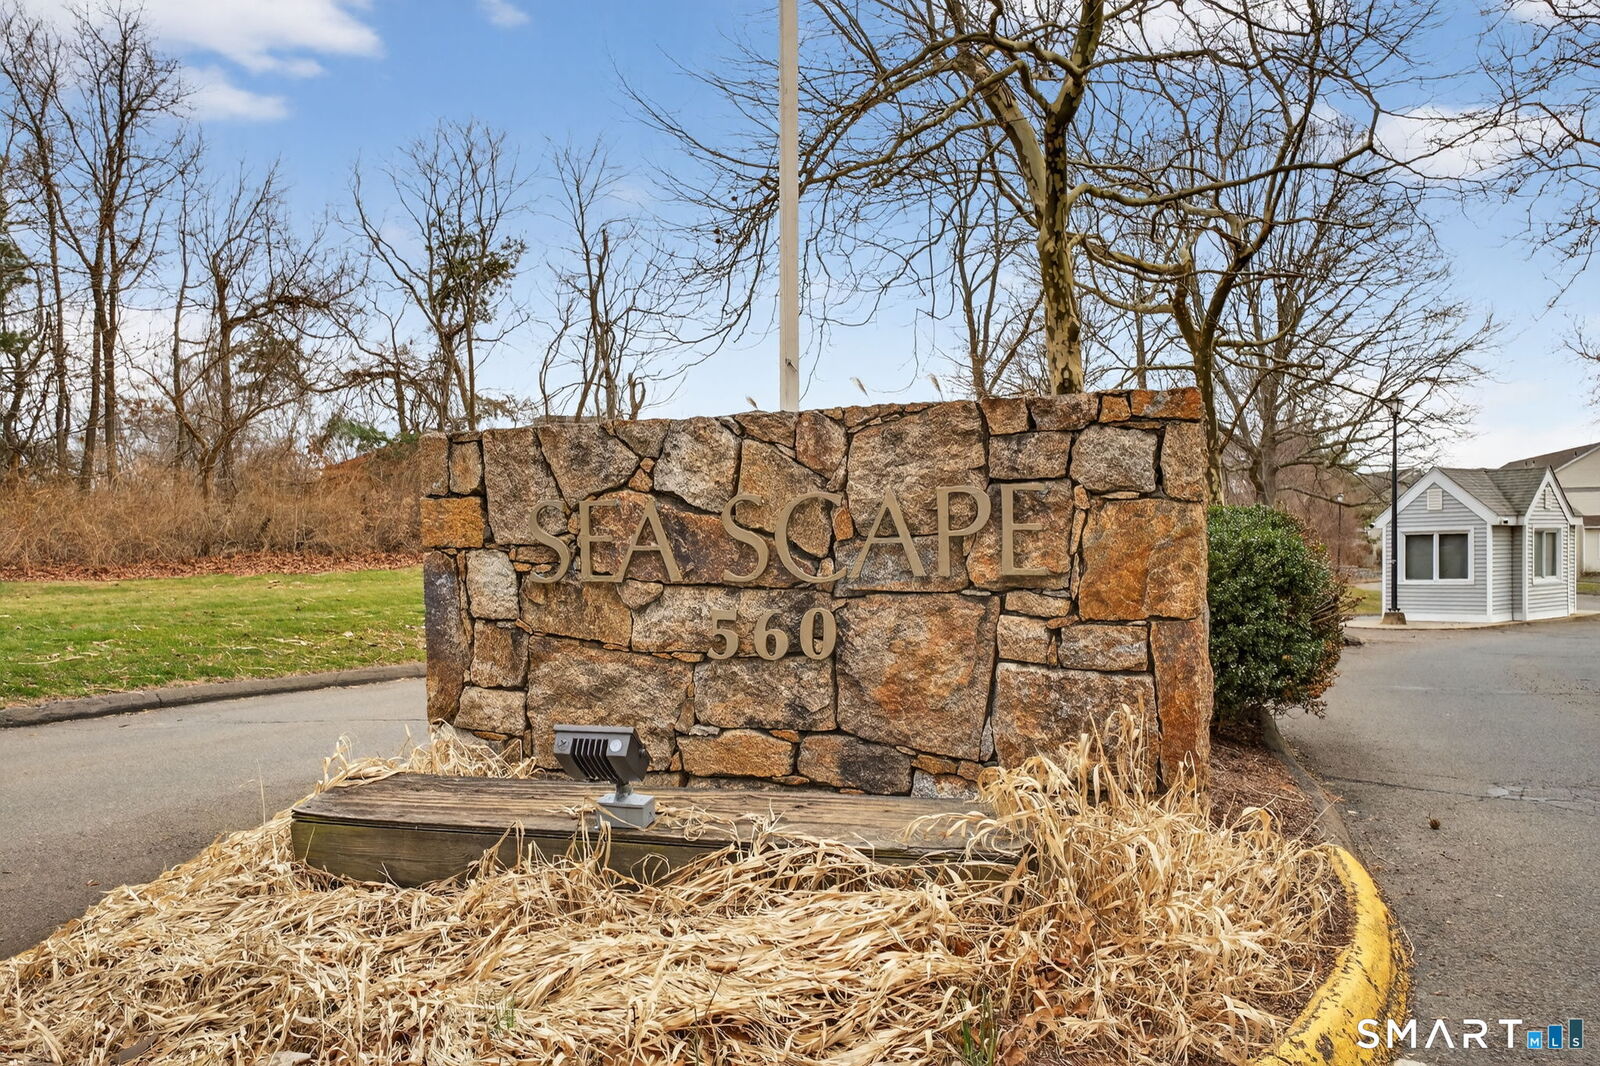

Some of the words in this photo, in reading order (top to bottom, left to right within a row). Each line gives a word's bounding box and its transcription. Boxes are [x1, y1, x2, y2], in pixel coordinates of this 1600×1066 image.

[528, 498, 684, 585] SEA
[722, 482, 1052, 584] SCAPE
[707, 608, 838, 661] 560
